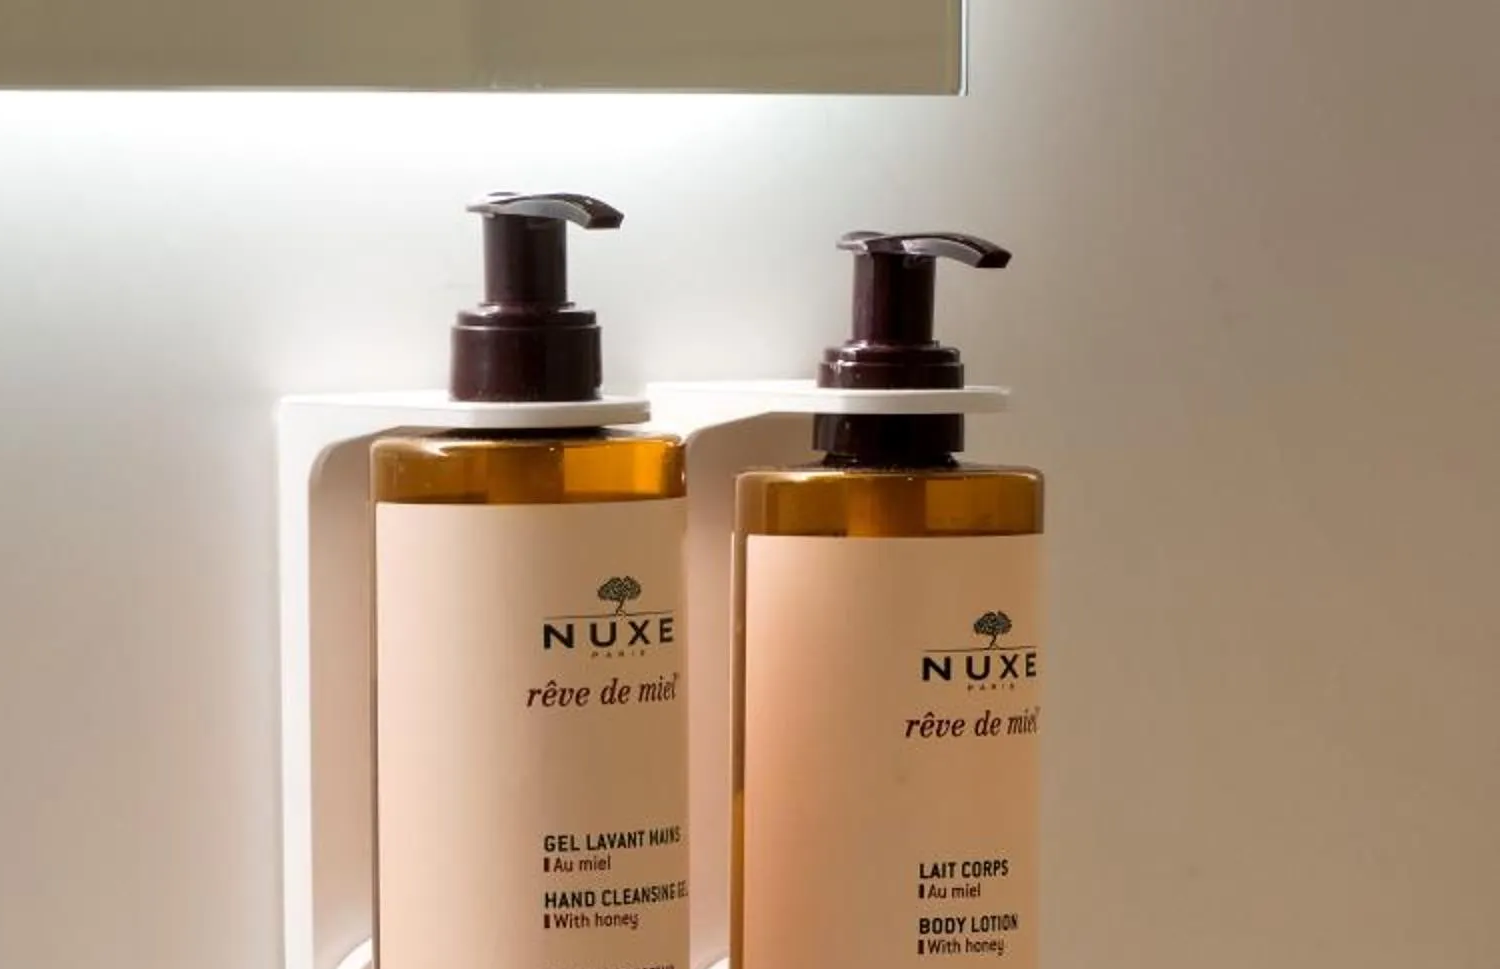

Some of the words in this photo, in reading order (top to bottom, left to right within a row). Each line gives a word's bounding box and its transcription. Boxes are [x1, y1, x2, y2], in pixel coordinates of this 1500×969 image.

[543, 617, 674, 650] NUXE
[591, 650, 646, 659] PARIS
[922, 652, 1037, 681] NUXE
[526, 680, 591, 708] rêve
[600, 677, 631, 705] de
[638, 672, 679, 703] miel
[967, 683, 1015, 692] PARIS
[905, 711, 966, 739] rêve
[974, 709, 1002, 736] de
[544, 835, 580, 852] GEL
[586, 829, 644, 851] LAVANT
[649, 825, 681, 846] MAINS
[553, 857, 574, 873] Au
[579, 855, 611, 872] miel
[919, 861, 957, 879] LAIT
[961, 859, 1009, 878] CORPS
[544, 891, 595, 909] HAND
[601, 882, 675, 908] CLEANSING
[927, 884, 947, 899] Au
[952, 883, 981, 898] miel
[553, 912, 590, 929] With
[595, 911, 639, 931] honey
[919, 916, 966, 935] BODY
[971, 913, 1019, 933] LOTION
[927, 938, 961, 955] With
[965, 938, 1004, 956] honey
